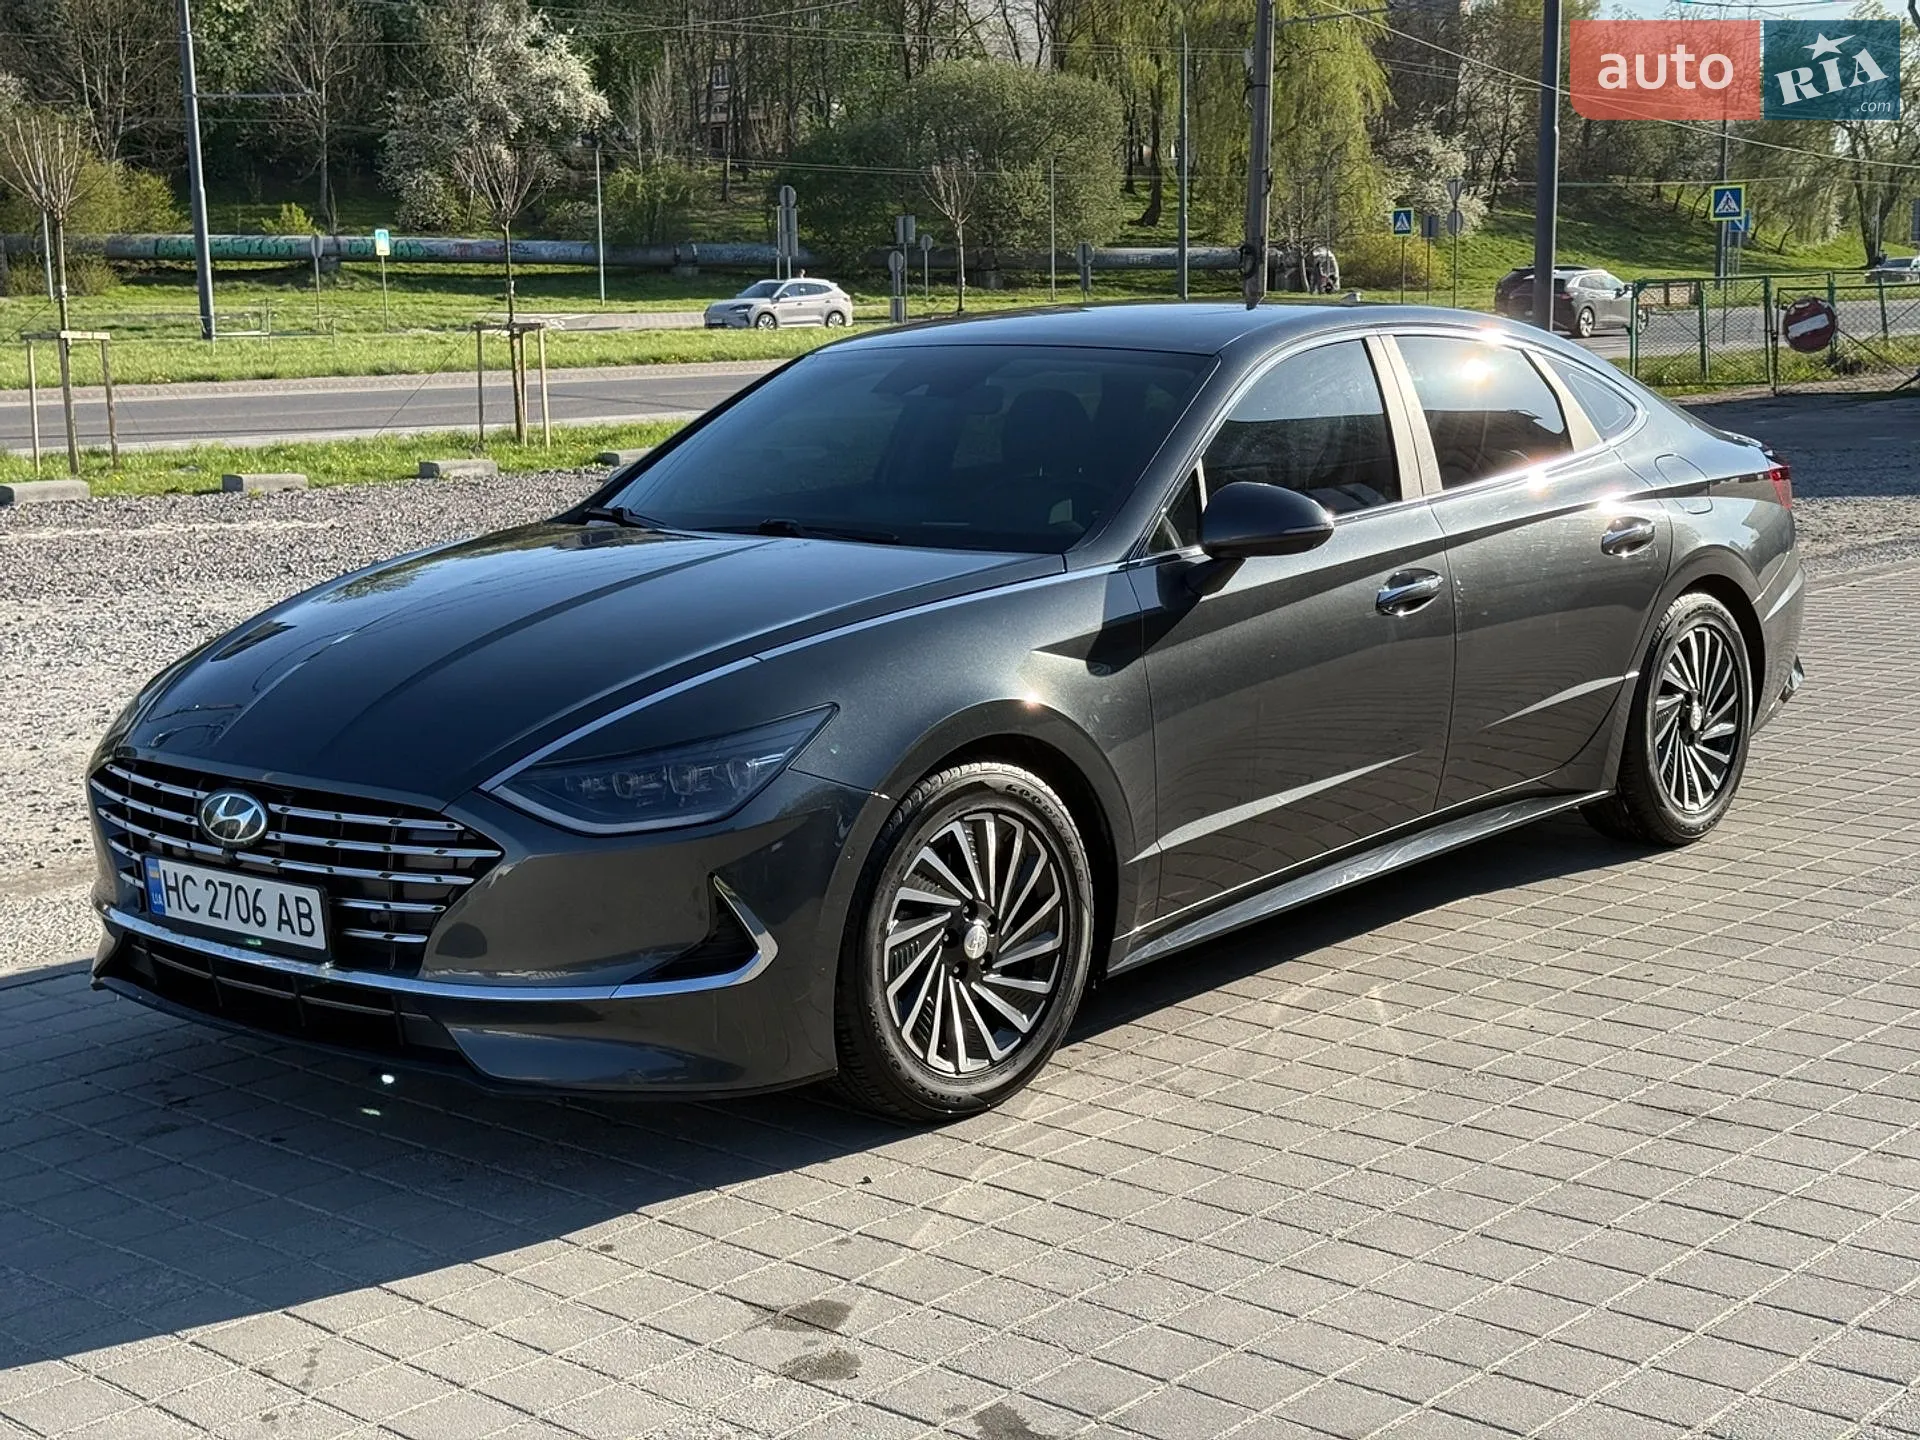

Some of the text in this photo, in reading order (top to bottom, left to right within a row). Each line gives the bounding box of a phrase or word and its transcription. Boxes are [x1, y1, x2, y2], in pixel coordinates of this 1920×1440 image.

[162, 869, 315, 938] HC 2706 AB
